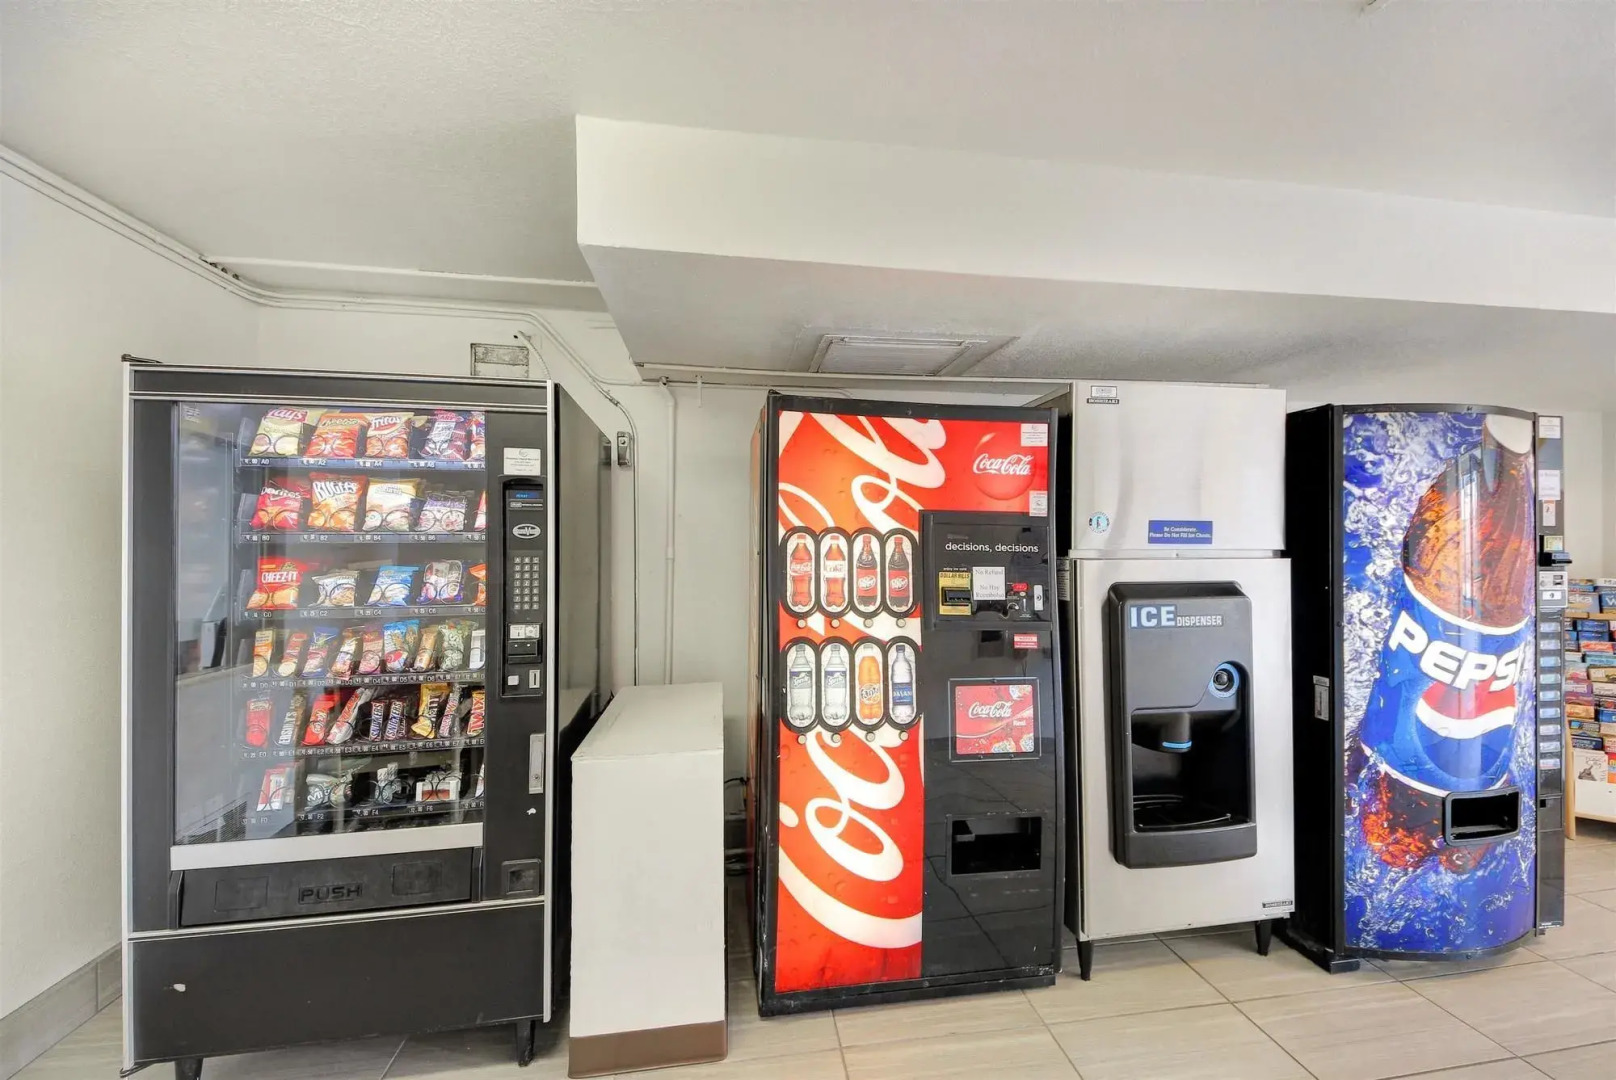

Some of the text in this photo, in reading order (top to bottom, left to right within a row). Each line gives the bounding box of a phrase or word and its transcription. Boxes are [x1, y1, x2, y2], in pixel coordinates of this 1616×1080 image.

[973, 453, 1034, 475] Coca-Cola
[945, 542, 1039, 553] decisions, decisions
[262, 571, 297, 583] CHEEZ-IT
[1130, 605, 1222, 628] ICE DISPENSER
[968, 701, 1014, 719] Coca-Cola
[302, 885, 362, 901] PUSH
